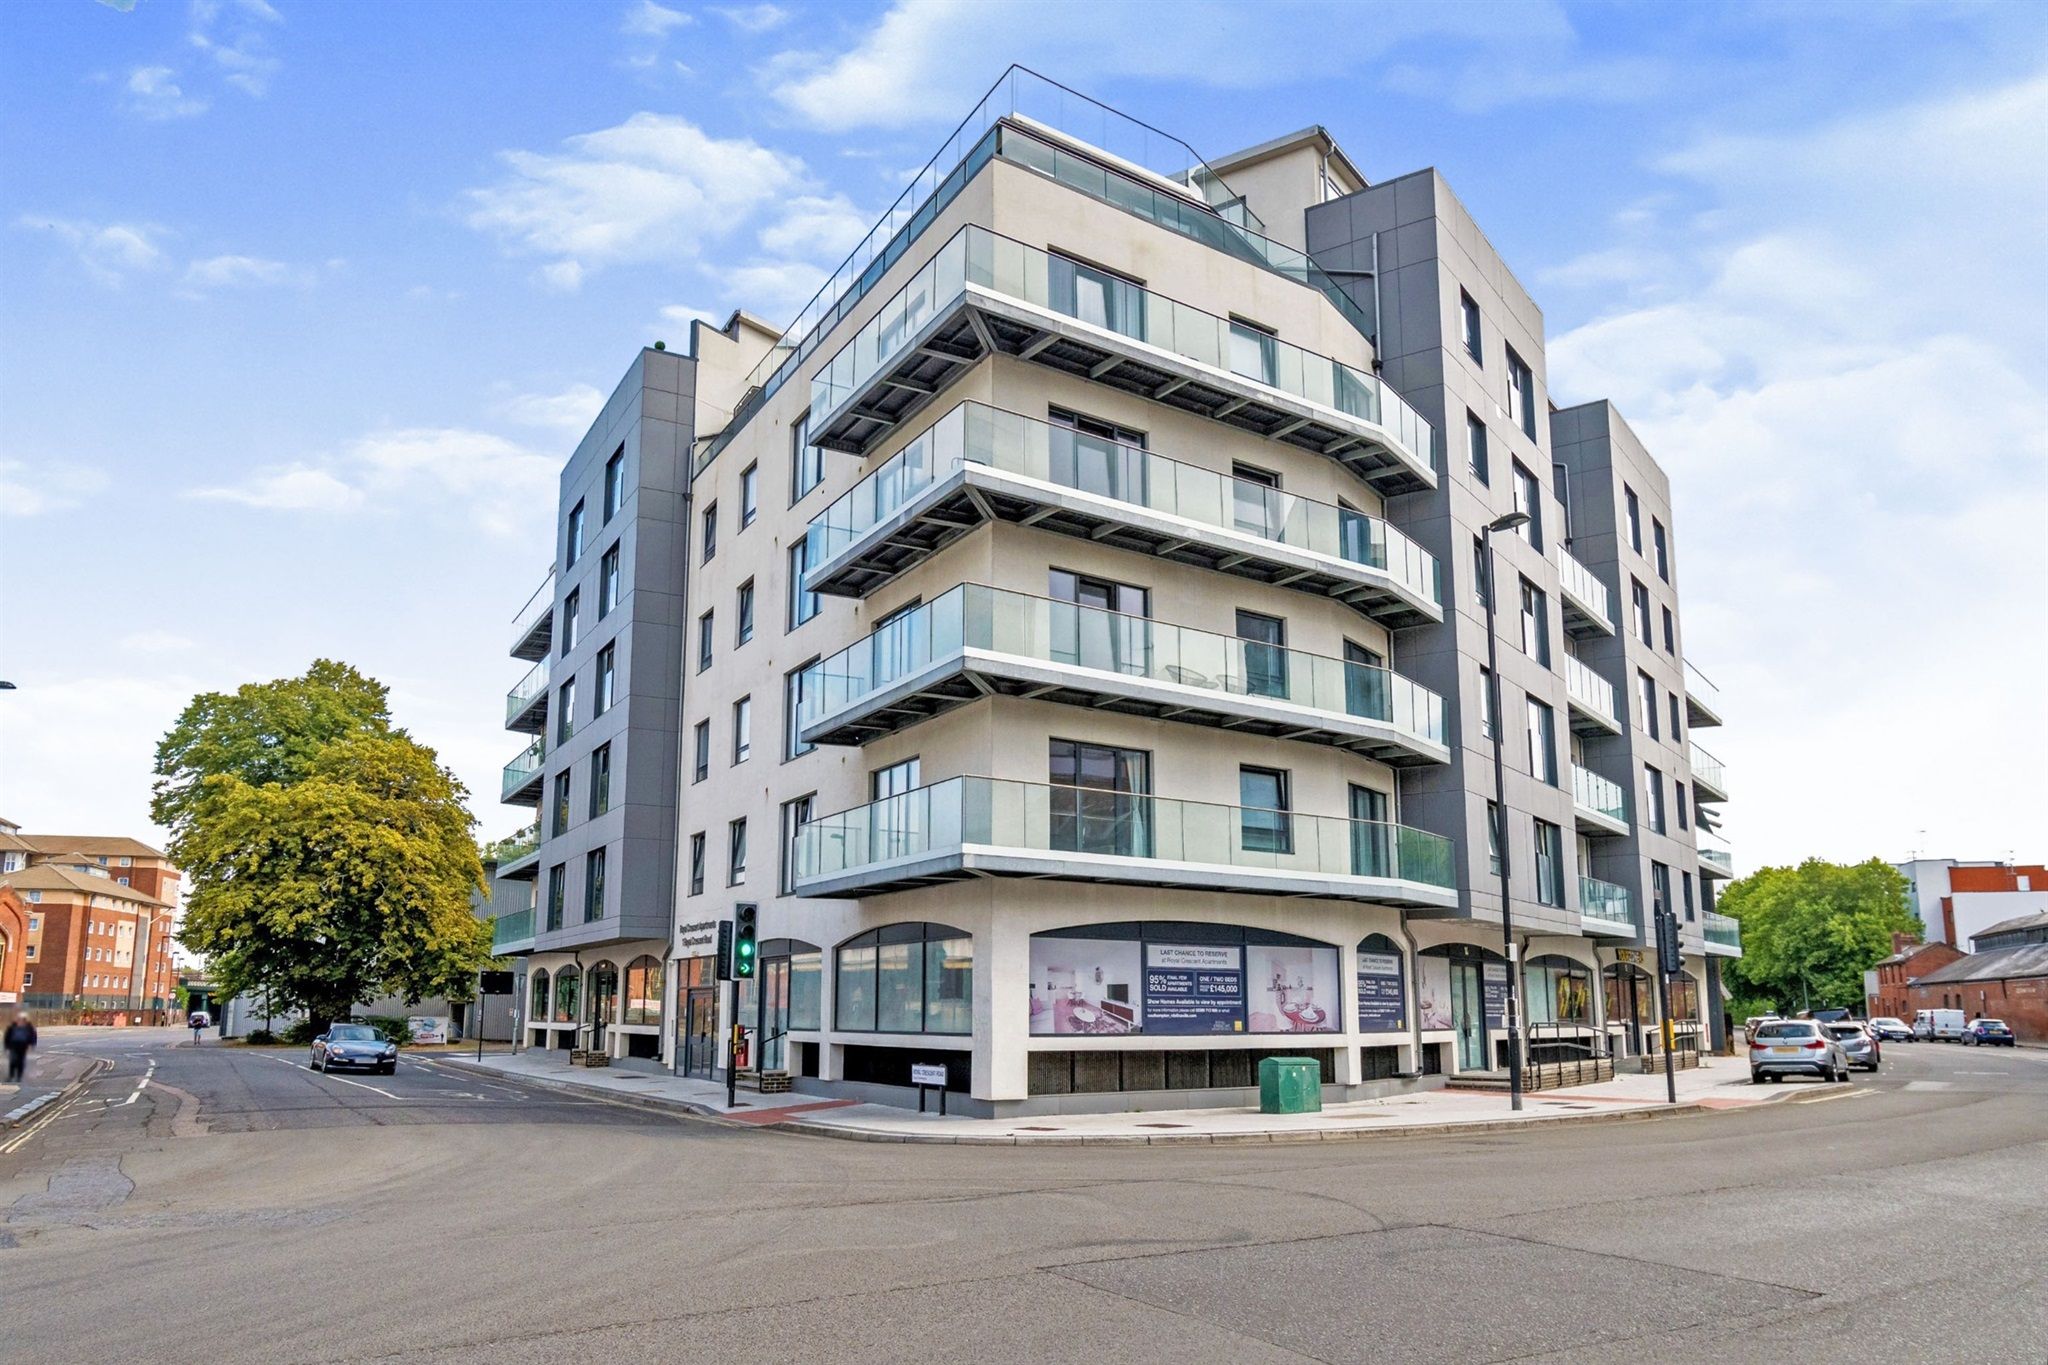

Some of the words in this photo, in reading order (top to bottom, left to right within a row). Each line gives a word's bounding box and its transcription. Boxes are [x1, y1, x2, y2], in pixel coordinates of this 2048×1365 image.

[1174, 949, 1196, 957] CHANCE
[1167, 957, 1180, 965] Royal
[1149, 975, 1167, 985] 95%
[1149, 984, 1167, 992] SOLD
[1210, 984, 1238, 993] £145,000
